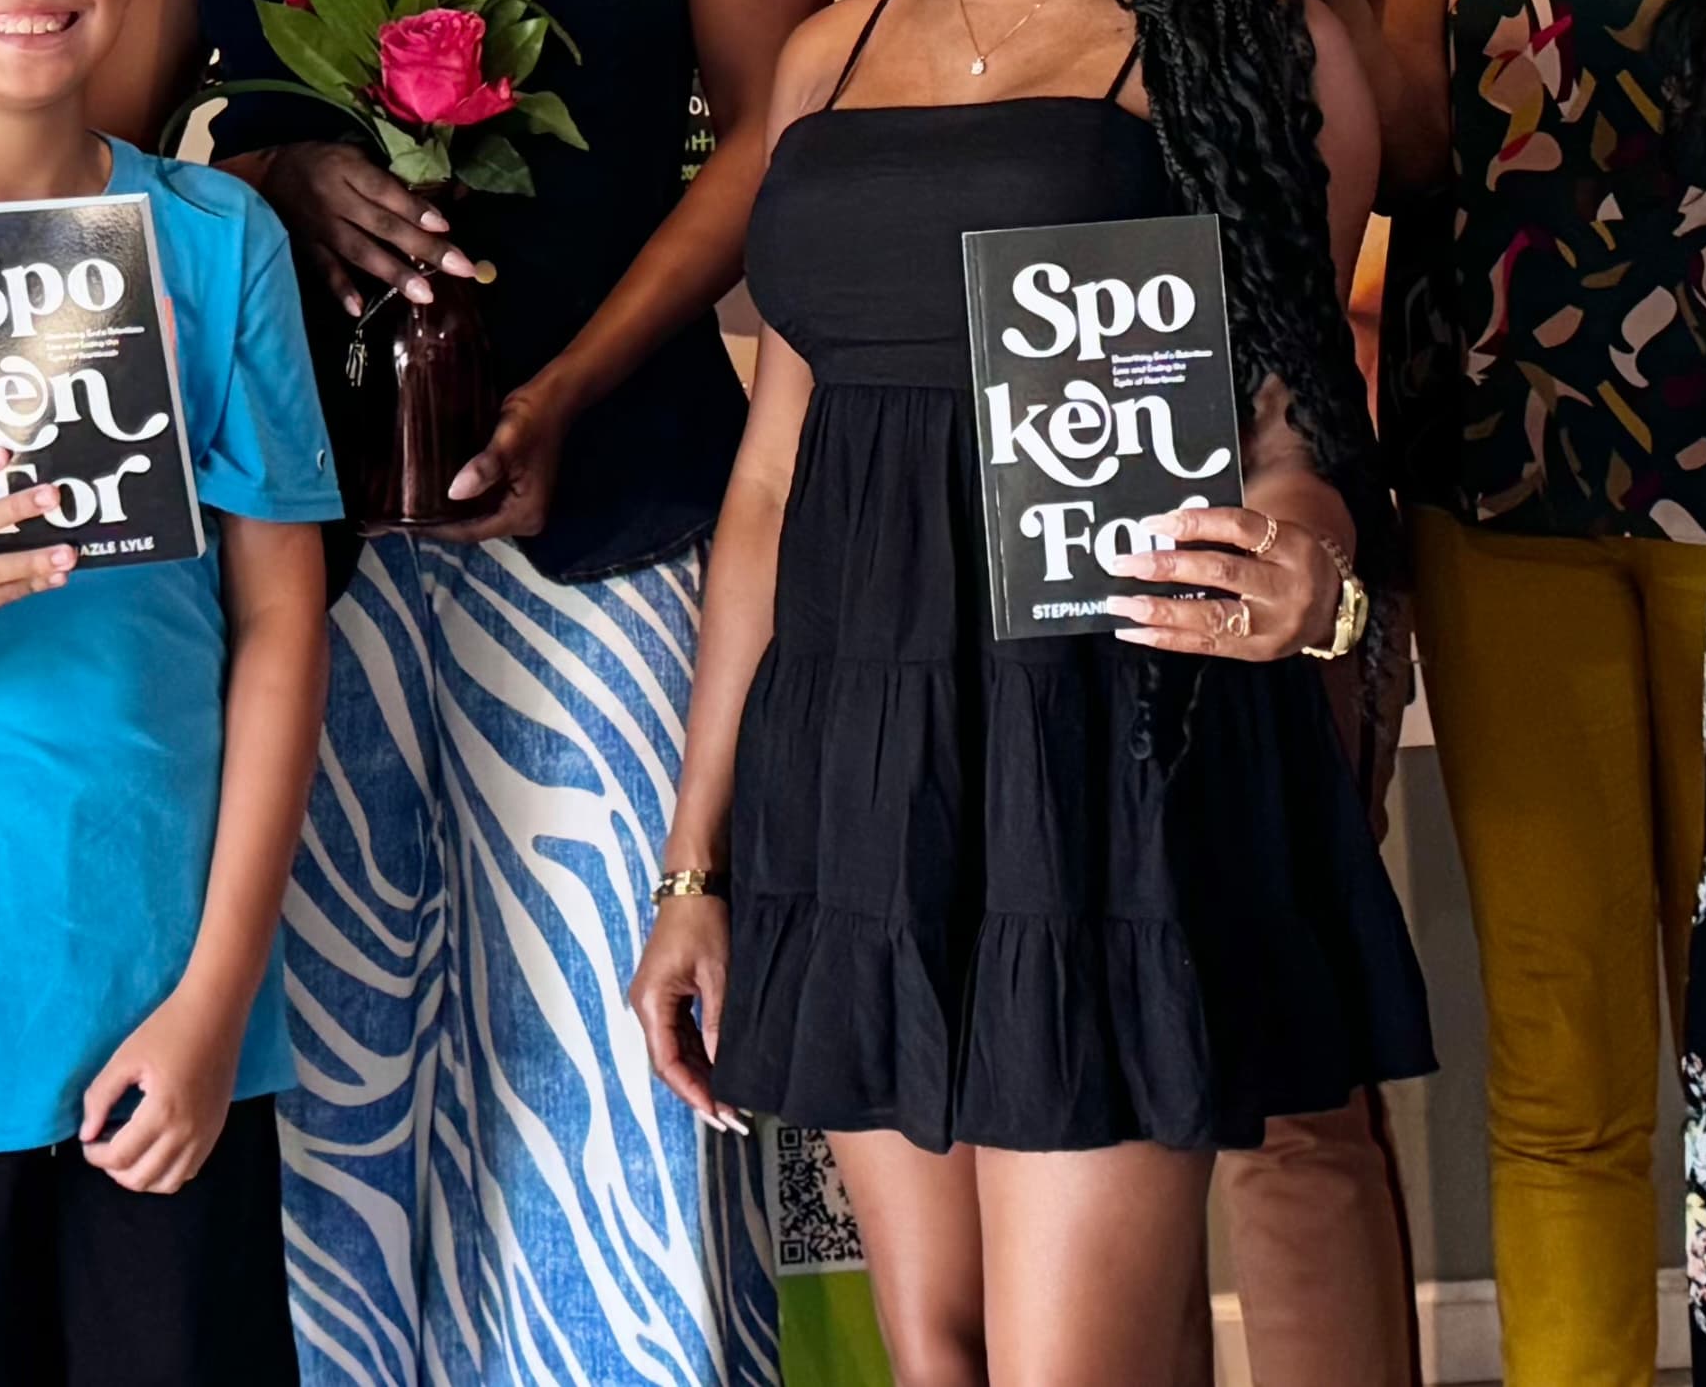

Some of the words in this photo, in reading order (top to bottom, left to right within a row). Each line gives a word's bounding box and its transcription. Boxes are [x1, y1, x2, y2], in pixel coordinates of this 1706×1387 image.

[1002, 263, 1196, 361] Spo
[984, 380, 1231, 487] ken
[79, 540, 116, 557] AZLE
[120, 536, 154, 554] LYLE
[1032, 599, 1109, 621] STEPHANI
